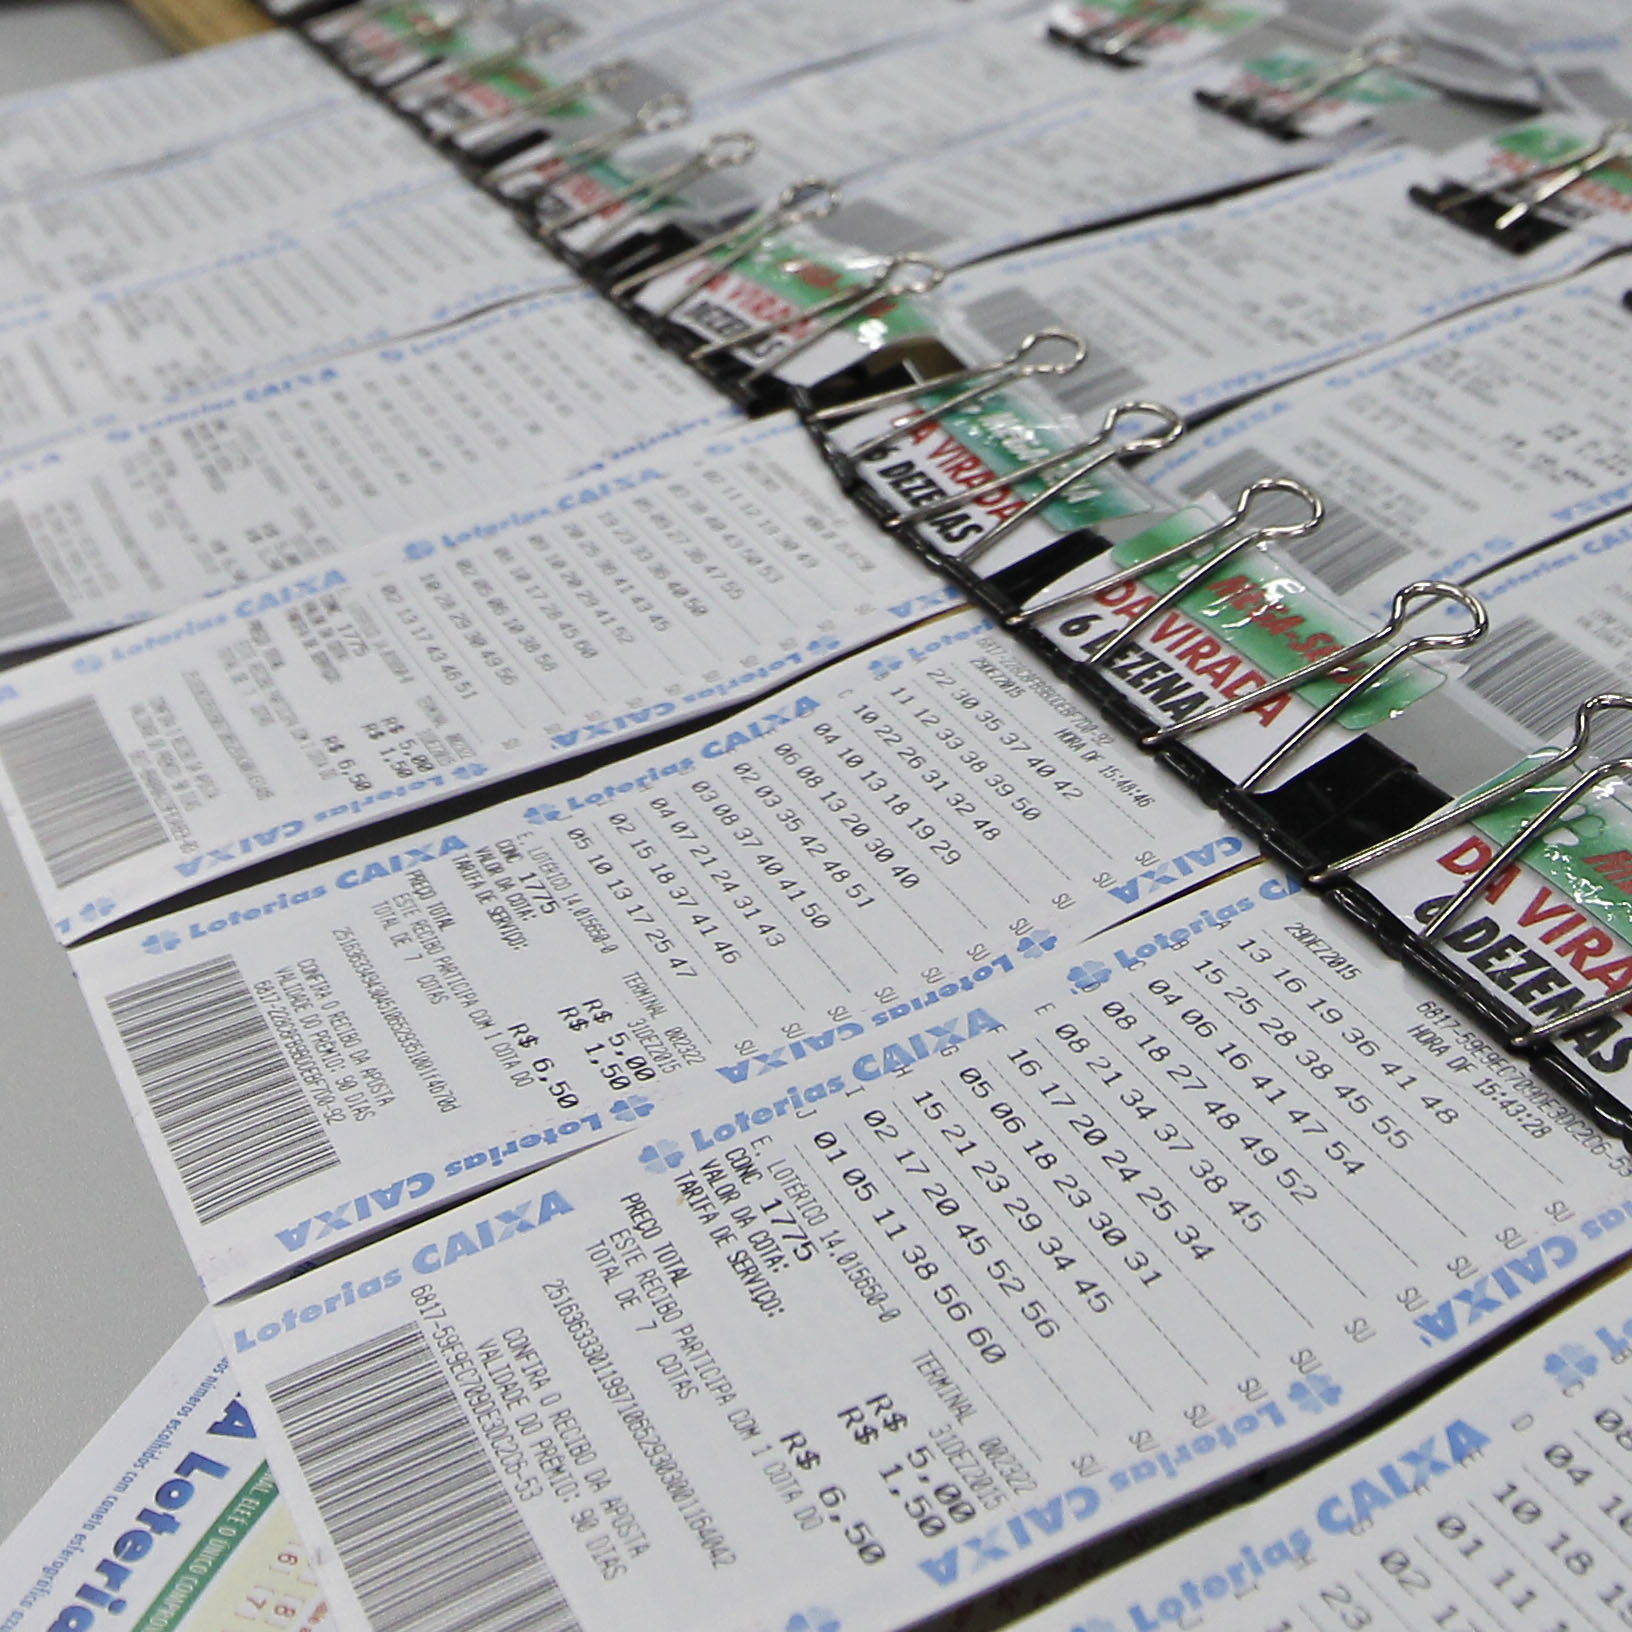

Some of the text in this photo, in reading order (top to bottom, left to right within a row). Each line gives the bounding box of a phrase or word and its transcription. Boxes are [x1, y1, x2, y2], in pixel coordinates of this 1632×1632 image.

[877, 460, 984, 545] DEZEAS
[1059, 614, 1103, 637] 6
[187, 835, 469, 943] Loterias CAIXA
[506, 1022, 580, 1110] R$ 6,50
[556, 1006, 632, 1091] R$ 1,50
[581, 998, 657, 1085] R$ 5,00
[621, 970, 707, 1066] TERMINAL 002322
[626, 1017, 683, 1076] 31DEZ2015
[1236, 938, 1273, 964] 13
[1272, 968, 1308, 994] 16
[1306, 997, 1344, 1024] 19
[1341, 1026, 1381, 1057] 36
[1380, 1062, 1418, 1092] 41
[1420, 1096, 1460, 1124] 48
[1283, 922, 1553, 1140] 29DEZ2015 HORA DF 15:43:28
[690, 1005, 1007, 1154] Loterias CAIXA
[274, 1112, 604, 1254] Loterias CAIXA
[724, 1146, 764, 1186] CONC
[759, 1198, 820, 1262] 1775
[234, 1189, 576, 1353] Loterias CAIXA
[584, 1238, 624, 1286] TOTAL
[614, 1287, 643, 1312] DE
[655, 1353, 700, 1400] COTAS
[608, 1227, 648, 1268] ESTE
[634, 1268, 684, 1327] RECIBO
[671, 1322, 738, 1407] PARTICIPA
[177, 1375, 220, 1417] números
[475, 1337, 531, 1415] VALIDADE
[506, 1411, 544, 1448] DO
[619, 1192, 887, 1565] PREÇO TOTAL R$ 6,50
[673, 1168, 947, 1538] TARIFA DE SERVIÇO: R$ 1,50
[698, 1157, 977, 1524] VALOR DA COTA: R$ 5,00
[911, 1348, 977, 1426] TERMINAL
[132, 1418, 184, 1468] escolhidos
[210, 1399, 258, 1440] A
[502, 1326, 552, 1392] CONFIRA
[548, 1407, 598, 1477] RECIBO
[583, 1467, 612, 1494] DA
[599, 1496, 652, 1559] APOSTA
[918, 1399, 1288, 1588] Loterias CAIXA
